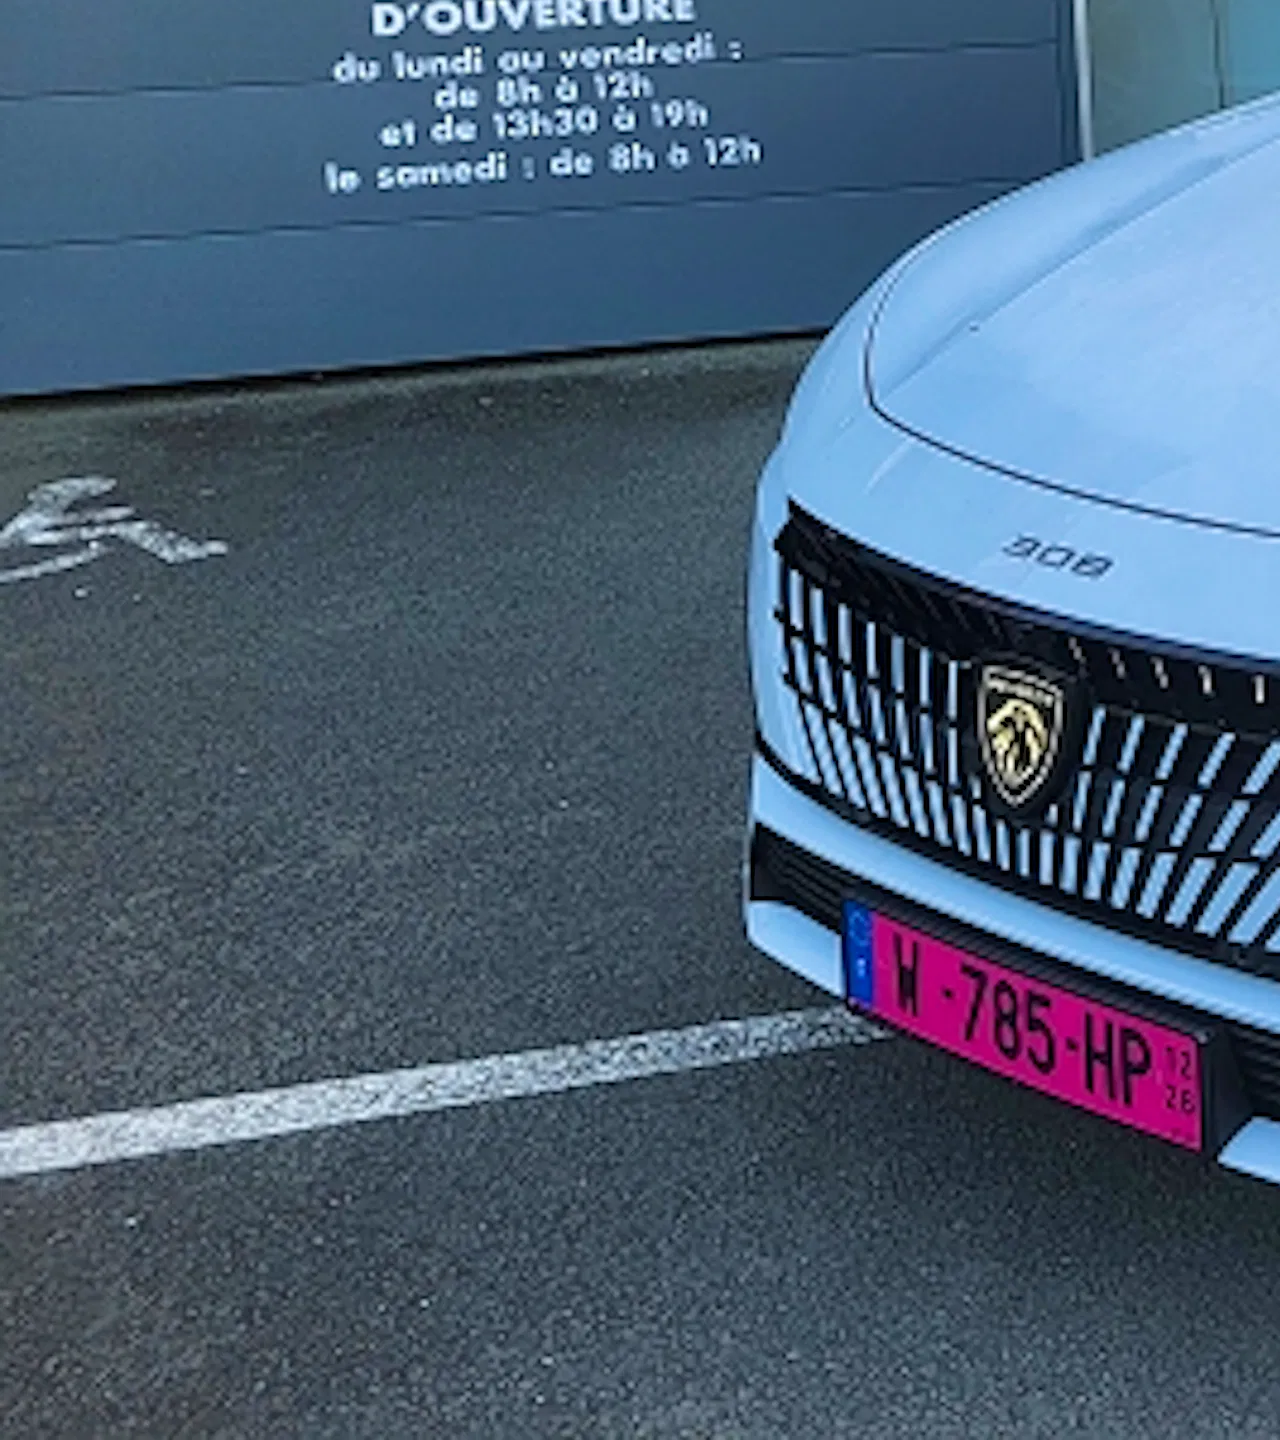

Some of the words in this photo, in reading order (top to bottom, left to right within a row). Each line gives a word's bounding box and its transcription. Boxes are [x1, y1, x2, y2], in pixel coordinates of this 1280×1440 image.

[333, 51, 380, 84] du
[393, 45, 484, 79] lundi
[499, 48, 545, 72] au
[560, 32, 716, 69] vendredi
[435, 77, 479, 110] de
[498, 76, 542, 104] 8h
[554, 73, 579, 102] à
[594, 69, 653, 100] 12h
[379, 119, 416, 148] et
[430, 113, 477, 144] de
[493, 107, 598, 140] 13h30
[613, 104, 637, 133] à
[651, 98, 709, 129] 19h
[324, 162, 361, 194] le
[376, 152, 507, 190] samedi
[549, 148, 594, 177] de
[608, 143, 656, 172] 8h
[703, 136, 763, 166] 12h
[1002, 536, 1114, 578] 308
